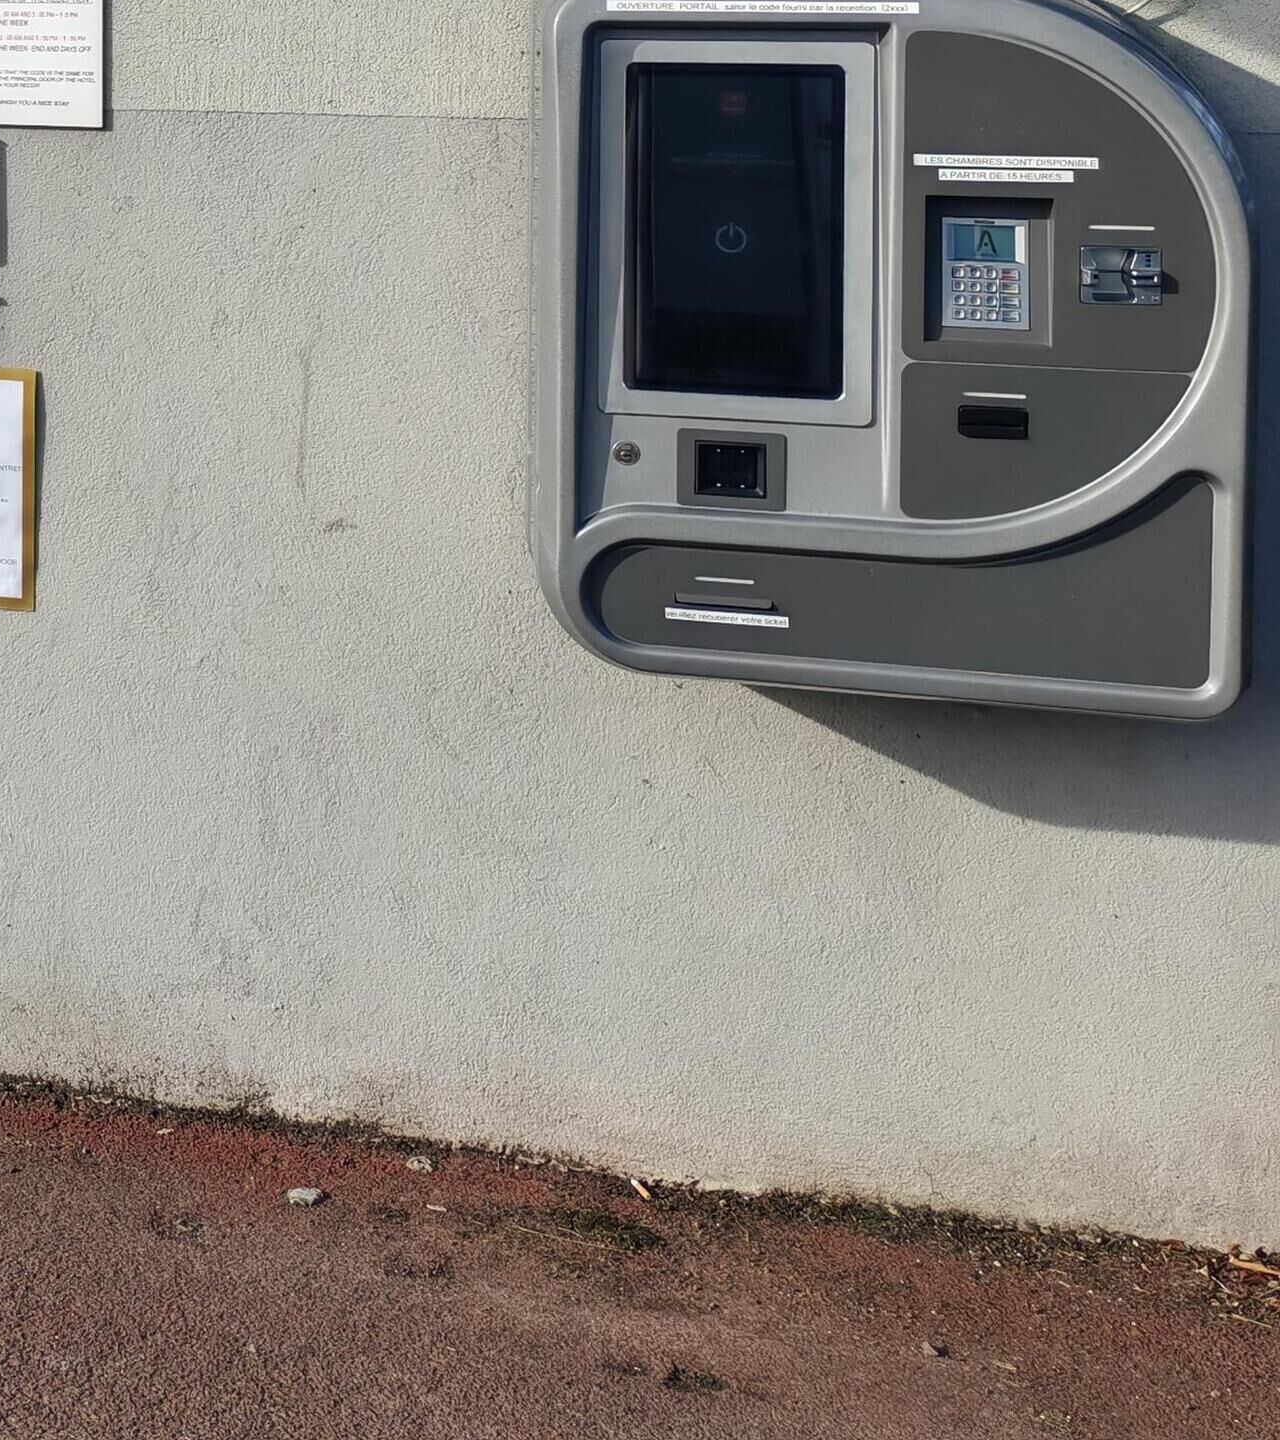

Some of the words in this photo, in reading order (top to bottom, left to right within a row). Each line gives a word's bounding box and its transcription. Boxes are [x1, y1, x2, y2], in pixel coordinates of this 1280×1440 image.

[616, 1, 673, 10] OUVERTURE
[679, 2, 719, 10] PORTAIL
[758, 3, 780, 11] code
[809, 5, 823, 13] par
[826, 3, 834, 12] la
[924, 156, 943, 165] LES
[946, 157, 1002, 166] CHAMBRES
[1004, 158, 1033, 167] SONT
[1035, 158, 1097, 168] DISPONIBLE
[940, 171, 949, 179] A
[950, 171, 987, 180] PARTIR
[990, 172, 1005, 180] DE
[1007, 172, 1019, 180] 15
[1020, 172, 1063, 181] HEURES
